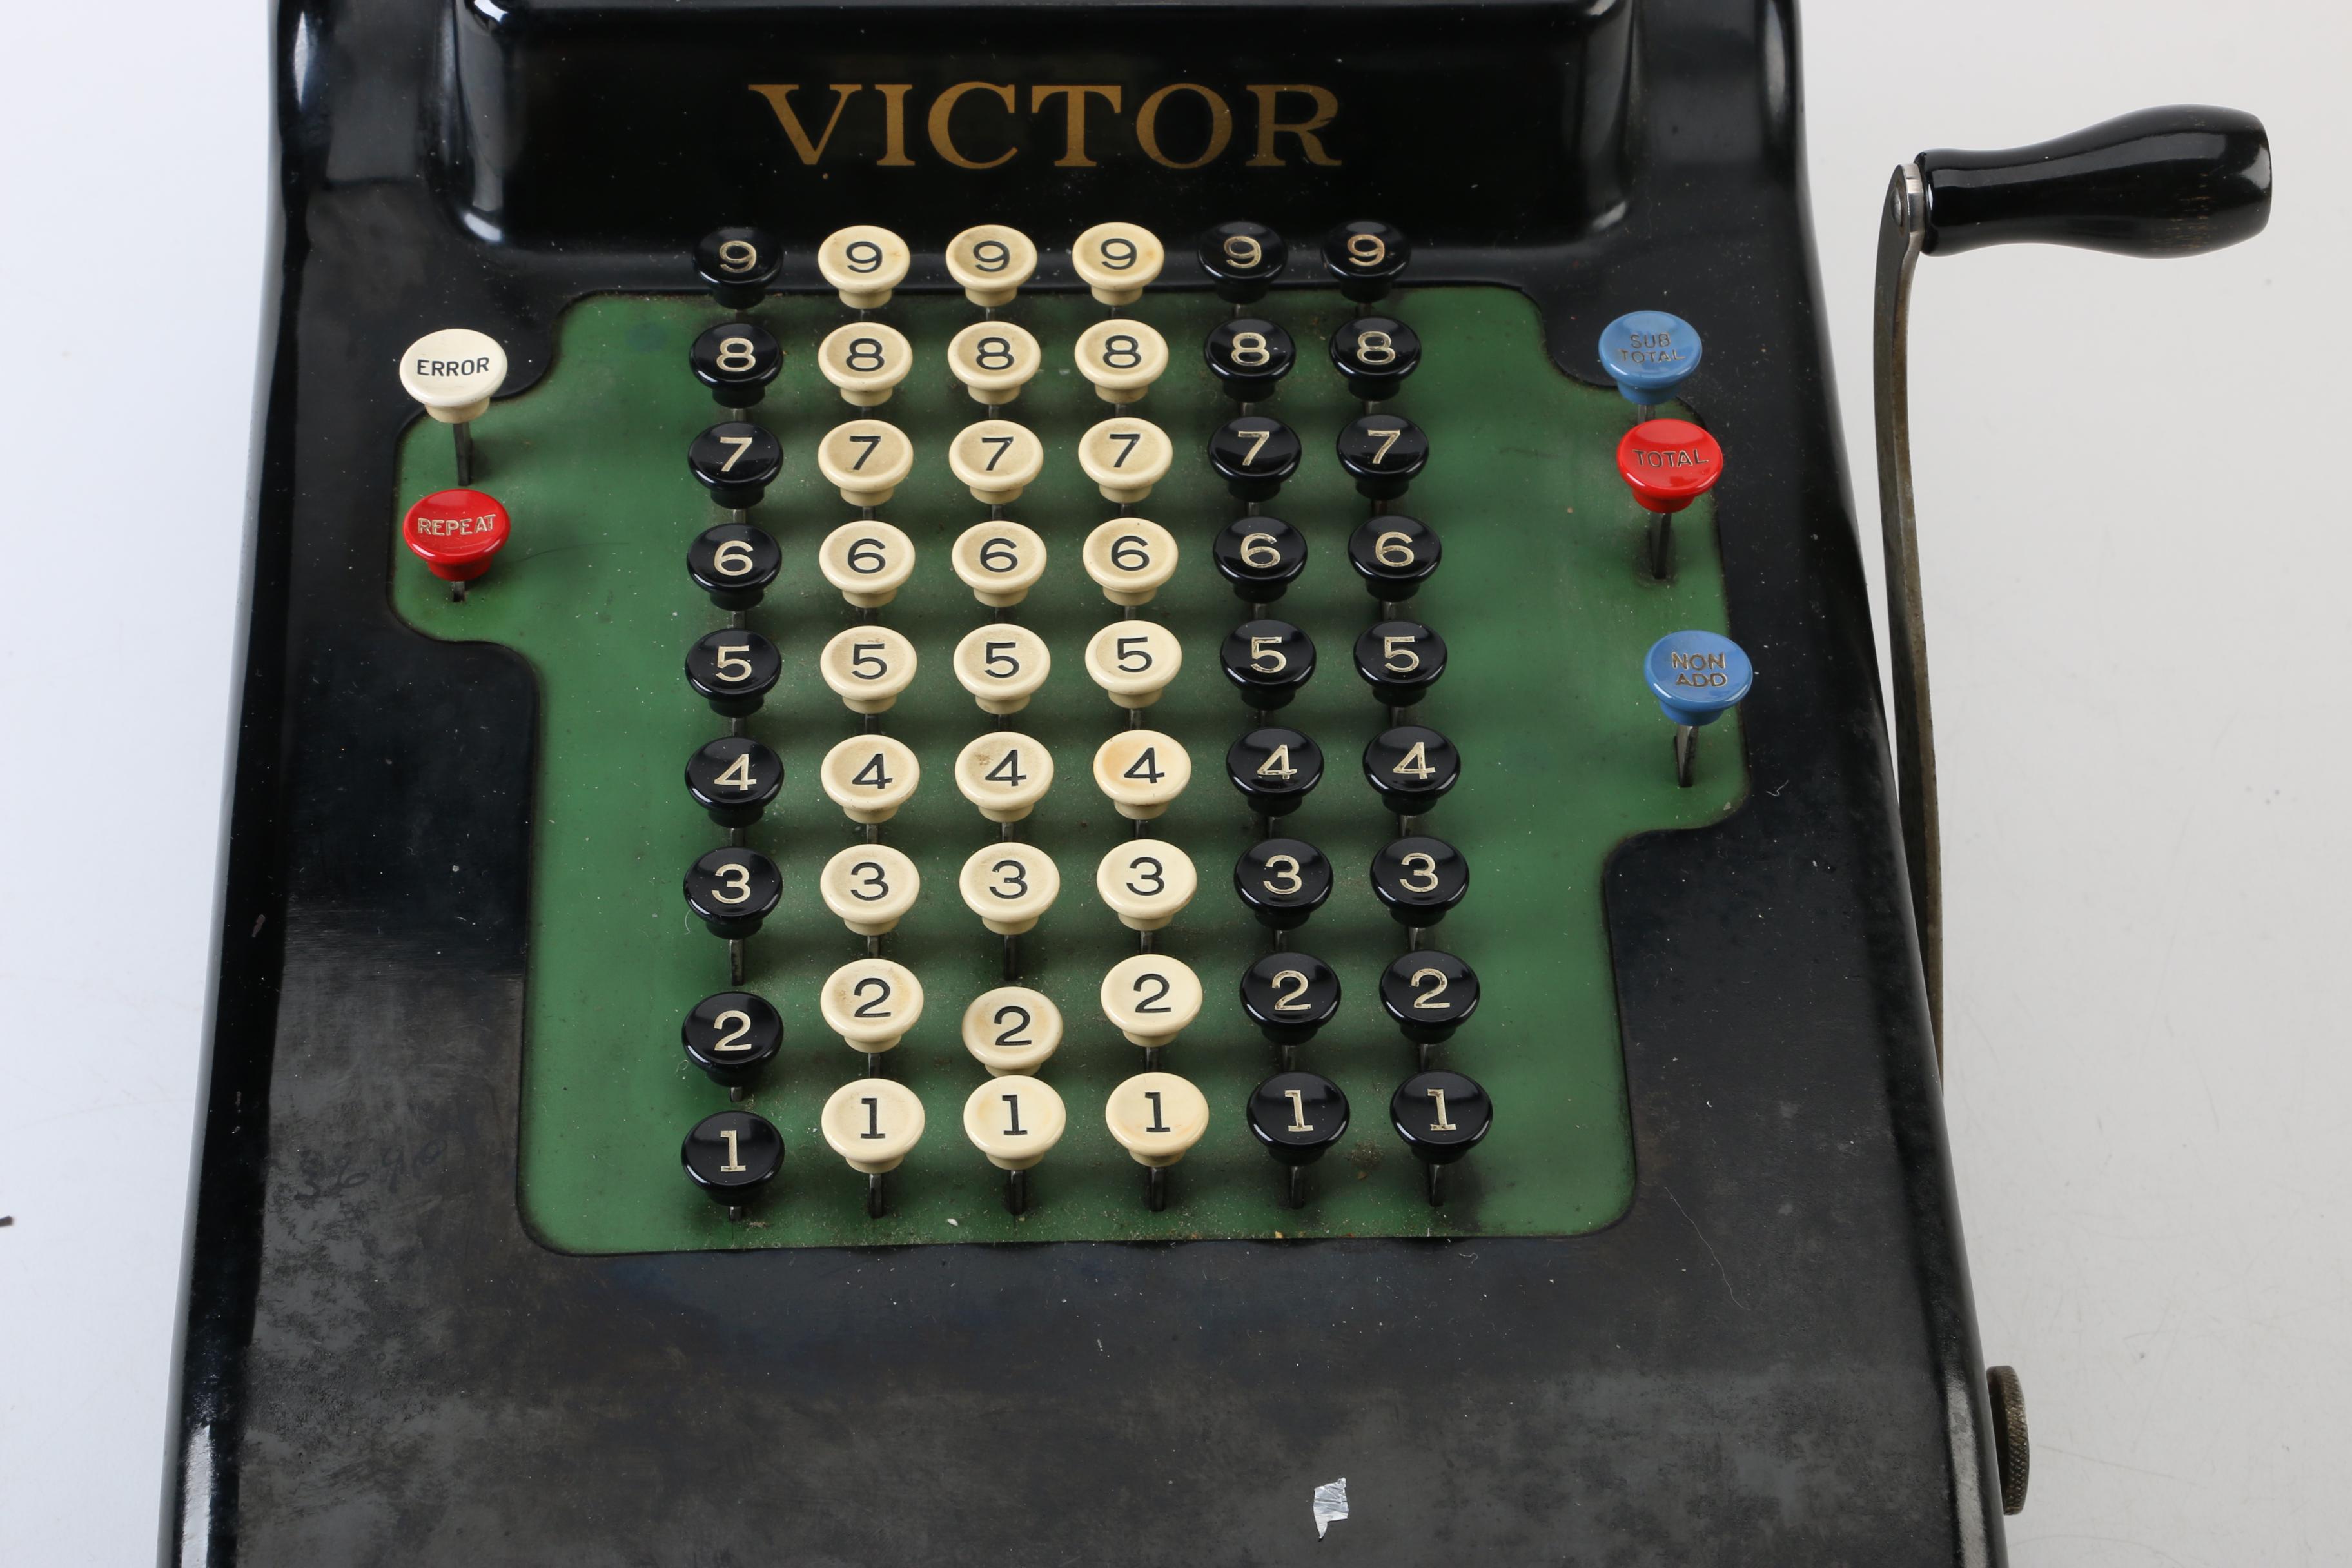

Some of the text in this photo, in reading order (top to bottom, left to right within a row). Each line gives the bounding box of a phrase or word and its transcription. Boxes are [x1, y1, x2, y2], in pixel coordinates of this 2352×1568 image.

[748, 81, 1343, 170] VICTOR
[718, 240, 758, 273] 9
[845, 240, 883, 274] 9
[972, 240, 1011, 273] 9
[1100, 237, 1138, 271] 9
[1224, 235, 1262, 269] 9
[1348, 233, 1386, 267] 9
[716, 337, 757, 373] 8
[845, 337, 885, 373] 8
[975, 336, 1015, 371] 8
[1102, 334, 1142, 369] 8
[1230, 331, 1271, 367] 8
[1356, 330, 1396, 365] 8
[1620, 349, 1686, 363] TOTAL
[1629, 331, 1672, 349] SUB
[416, 357, 490, 377] ERROR
[719, 436, 754, 473] 7
[848, 435, 882, 471] 7
[981, 436, 1014, 472] 7
[1108, 433, 1141, 469] 7
[1237, 430, 1271, 467] 7
[1367, 429, 1402, 465] 7
[1631, 448, 1709, 468] TOTAL
[417, 514, 496, 536] REPEAT
[713, 539, 754, 577] 6
[847, 538, 887, 574] 6
[979, 537, 1019, 573] 6
[1110, 534, 1150, 572] 6
[1239, 532, 1282, 569] 6
[1375, 531, 1415, 568] 6
[714, 644, 753, 683] 5
[851, 643, 888, 680] 5
[983, 641, 1020, 679] 5
[1117, 636, 1153, 674] 5
[1250, 635, 1288, 674] 5
[1384, 634, 1420, 673] 5
[1671, 651, 1726, 671] NON
[1676, 672, 1728, 687] ADD
[713, 752, 758, 792] 4
[851, 752, 894, 790] 4
[984, 749, 1027, 787] 4
[1123, 747, 1166, 785] 4
[1256, 743, 1298, 781] 4
[1392, 741, 1437, 780] 4
[710, 863, 752, 905] 3
[850, 861, 890, 902] 3
[988, 859, 1028, 900] 3
[1125, 856, 1165, 897] 3
[1262, 854, 1303, 896] 3
[1398, 852, 1440, 893] 3
[853, 977, 892, 1019] 2
[1133, 972, 1172, 1014] 2
[1271, 969, 1312, 1012] 2
[1410, 967, 1451, 1010] 2
[713, 1009, 753, 1052] 2
[993, 1005, 1033, 1047] 2
[860, 1097, 886, 1140] 1
[1001, 1093, 1028, 1137] 1
[1144, 1091, 1171, 1133] 1
[1284, 1088, 1315, 1133] 1
[1426, 1088, 1458, 1132] 1
[719, 1128, 747, 1173] 1
